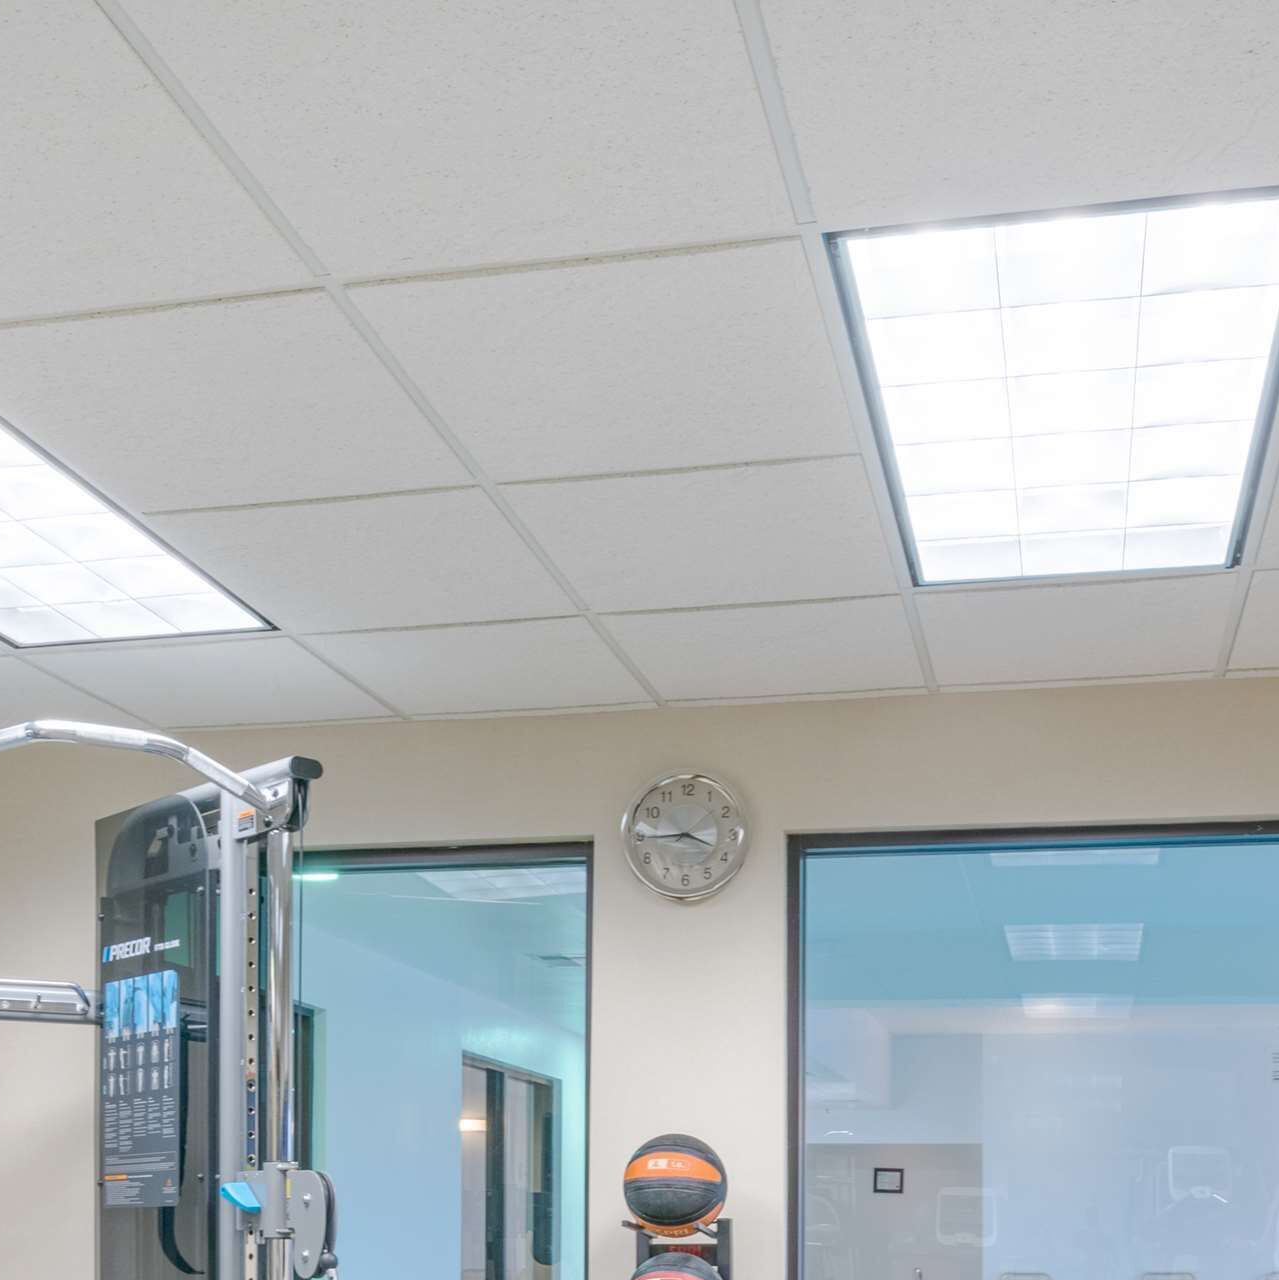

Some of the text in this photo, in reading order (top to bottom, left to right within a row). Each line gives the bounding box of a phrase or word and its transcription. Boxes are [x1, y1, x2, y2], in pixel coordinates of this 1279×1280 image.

[681, 783, 696, 796] 12
[660, 790, 673, 803] 11
[707, 791, 712, 802] 1
[646, 806, 660, 818] 10
[721, 806, 730, 818] 2
[728, 828, 737, 841] 3
[720, 852, 728, 862] 4
[663, 867, 670, 879] 7
[704, 867, 712, 880] 5
[681, 874, 690, 887] 6
[109, 937, 152, 962] PRECOR
